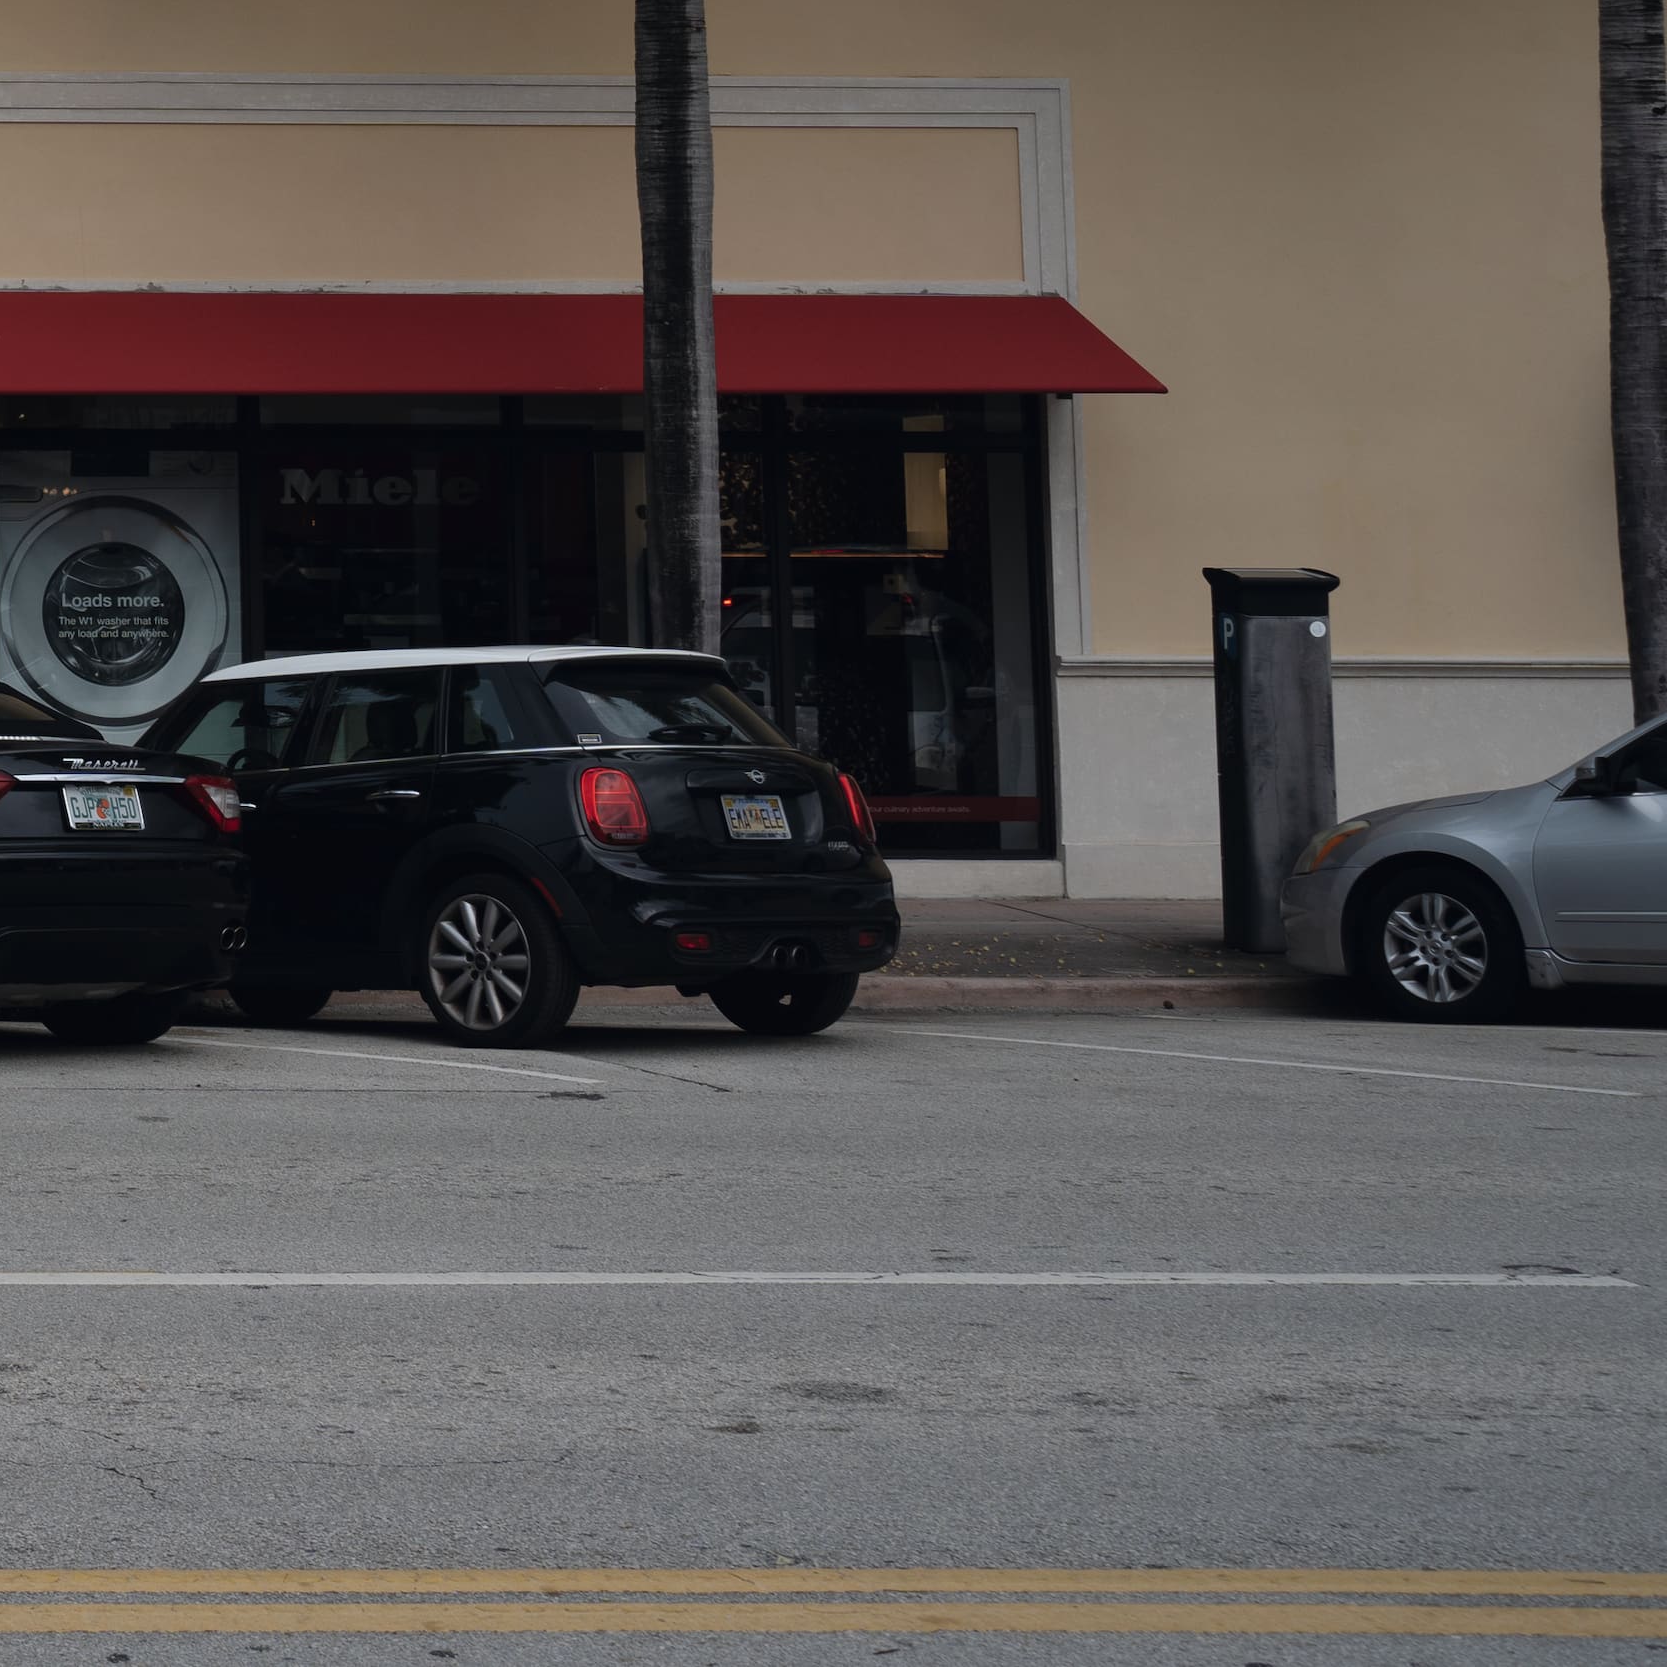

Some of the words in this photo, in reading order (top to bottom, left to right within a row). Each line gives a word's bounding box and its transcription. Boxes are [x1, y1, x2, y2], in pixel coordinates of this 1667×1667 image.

[279, 467, 479, 506] Miele
[61, 593, 113, 608] Loads
[117, 595, 165, 608] more.
[58, 616, 76, 625] The
[78, 616, 93, 625] W1
[97, 616, 131, 625] washer
[133, 616, 152, 625] that
[153, 616, 169, 625] fits
[58, 631, 75, 640] any
[78, 629, 98, 638] load
[100, 629, 119, 638] and
[121, 629, 169, 640] anywhere.
[1223, 617, 1235, 650] P
[70, 797, 95, 819] GJP
